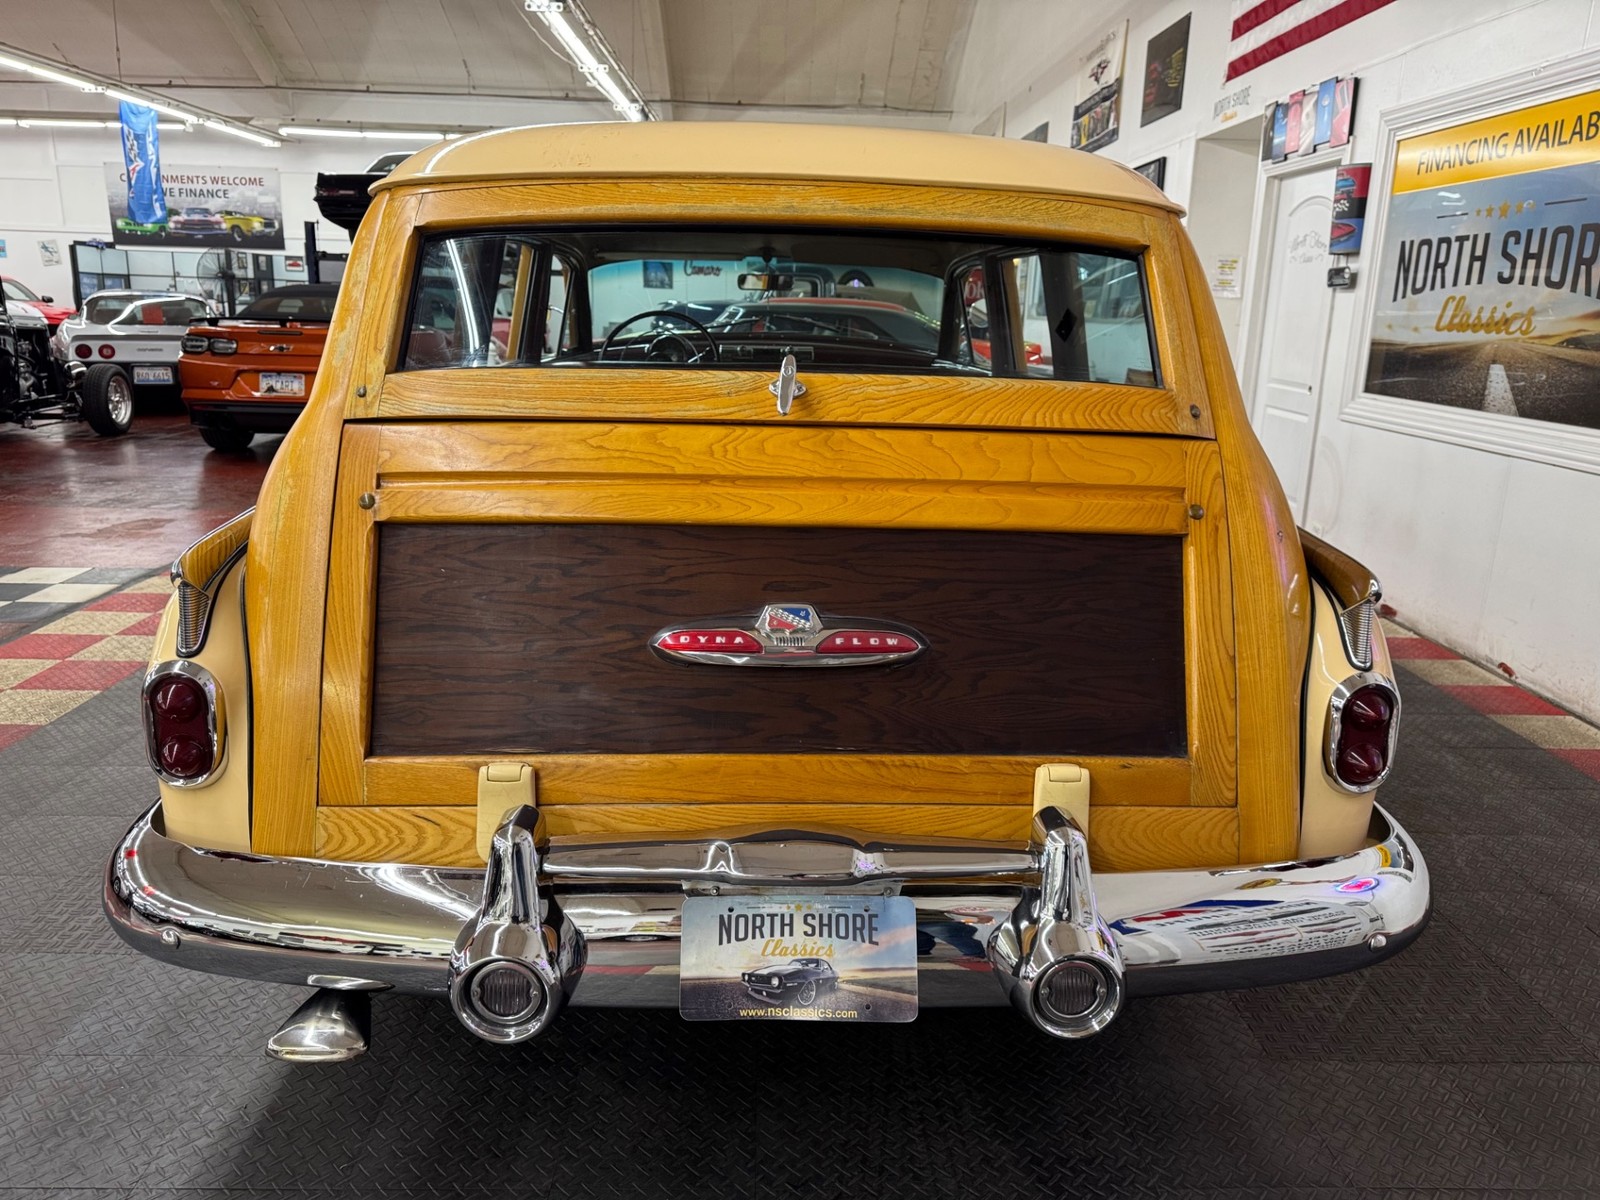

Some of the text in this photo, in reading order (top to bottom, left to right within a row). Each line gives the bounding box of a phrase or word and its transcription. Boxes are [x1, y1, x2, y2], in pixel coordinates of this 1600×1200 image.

[1416, 131, 1509, 175] FINANCING
[211, 174, 265, 187] WELCOME
[178, 187, 229, 199] FINANCE
[1392, 222, 1600, 303] NORTH SHOR
[1434, 294, 1538, 337] Classics
[679, 634, 899, 646] DYNA FLOW
[718, 913, 880, 946] NORTH SHORE
[760, 938, 836, 958] Classics
[739, 1006, 858, 1019] www.nsclassics.com
